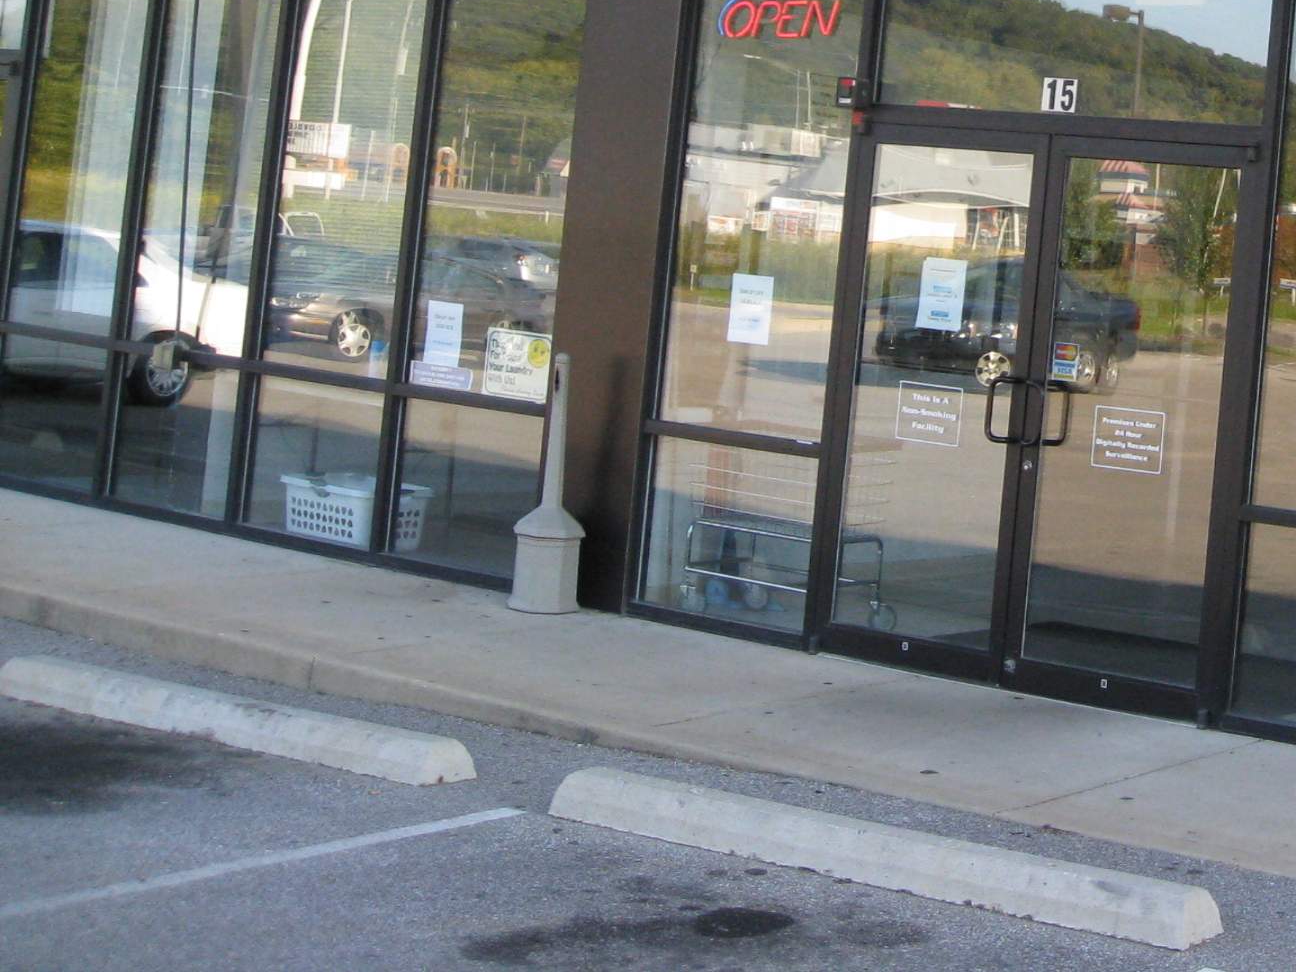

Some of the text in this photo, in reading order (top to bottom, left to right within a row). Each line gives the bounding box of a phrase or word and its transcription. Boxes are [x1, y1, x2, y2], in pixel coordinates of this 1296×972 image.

[1046, 78, 1076, 112] 15
[912, 392, 931, 403] This
[942, 396, 950, 405] A
[911, 420, 945, 434] Facility
